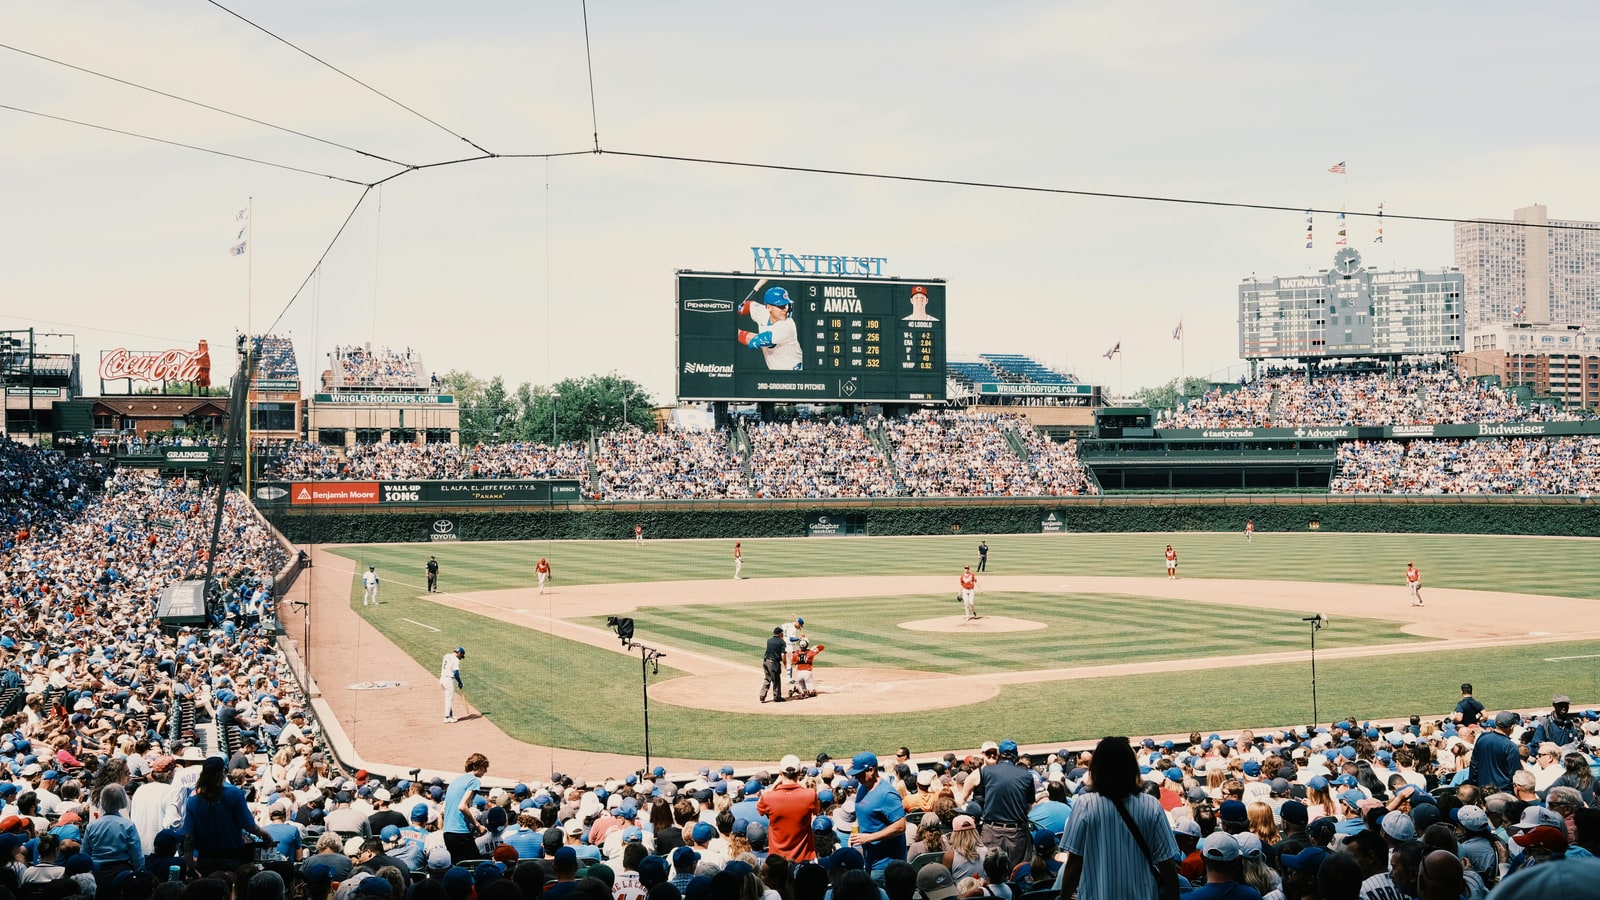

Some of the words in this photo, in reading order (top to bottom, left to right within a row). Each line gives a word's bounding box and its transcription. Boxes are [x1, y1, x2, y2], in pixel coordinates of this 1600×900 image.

[750, 247, 887, 276] WINTRUST
[1280, 278, 1325, 288] NATIONAL
[1371, 273, 1418, 284] AMERICAN
[809, 286, 817, 297] 9
[823, 286, 857, 298] MIGUEL
[810, 302, 816, 311] C
[824, 299, 862, 313] AMAYA
[831, 319, 842, 328] 116
[865, 320, 879, 329] .190
[834, 332, 839, 341] 2
[865, 333, 880, 341] .256
[833, 345, 840, 354] 13
[99, 348, 207, 382] Coca-Cola
[834, 358, 839, 367] 9
[865, 359, 880, 367] .532
[694, 363, 734, 373] National
[804, 383, 826, 391] PITCHER
[997, 385, 1078, 393] WRIGLEYROOFTOPS.COM
[331, 394, 438, 403] WRIGLEYROOFTOPS.COM
[1307, 429, 1348, 437] Advocate
[1479, 424, 1544, 434] Budweiser
[1209, 430, 1253, 438] tastytrade
[313, 491, 348, 500] Benjamin
[350, 490, 375, 498] Moore
[385, 492, 419, 501] SONG
[181, 773, 197, 785] MOR
[485, 840, 504, 852] BAE
[611, 882, 622, 894] DE
[622, 880, 633, 888] LA
[634, 882, 649, 893] CRU
